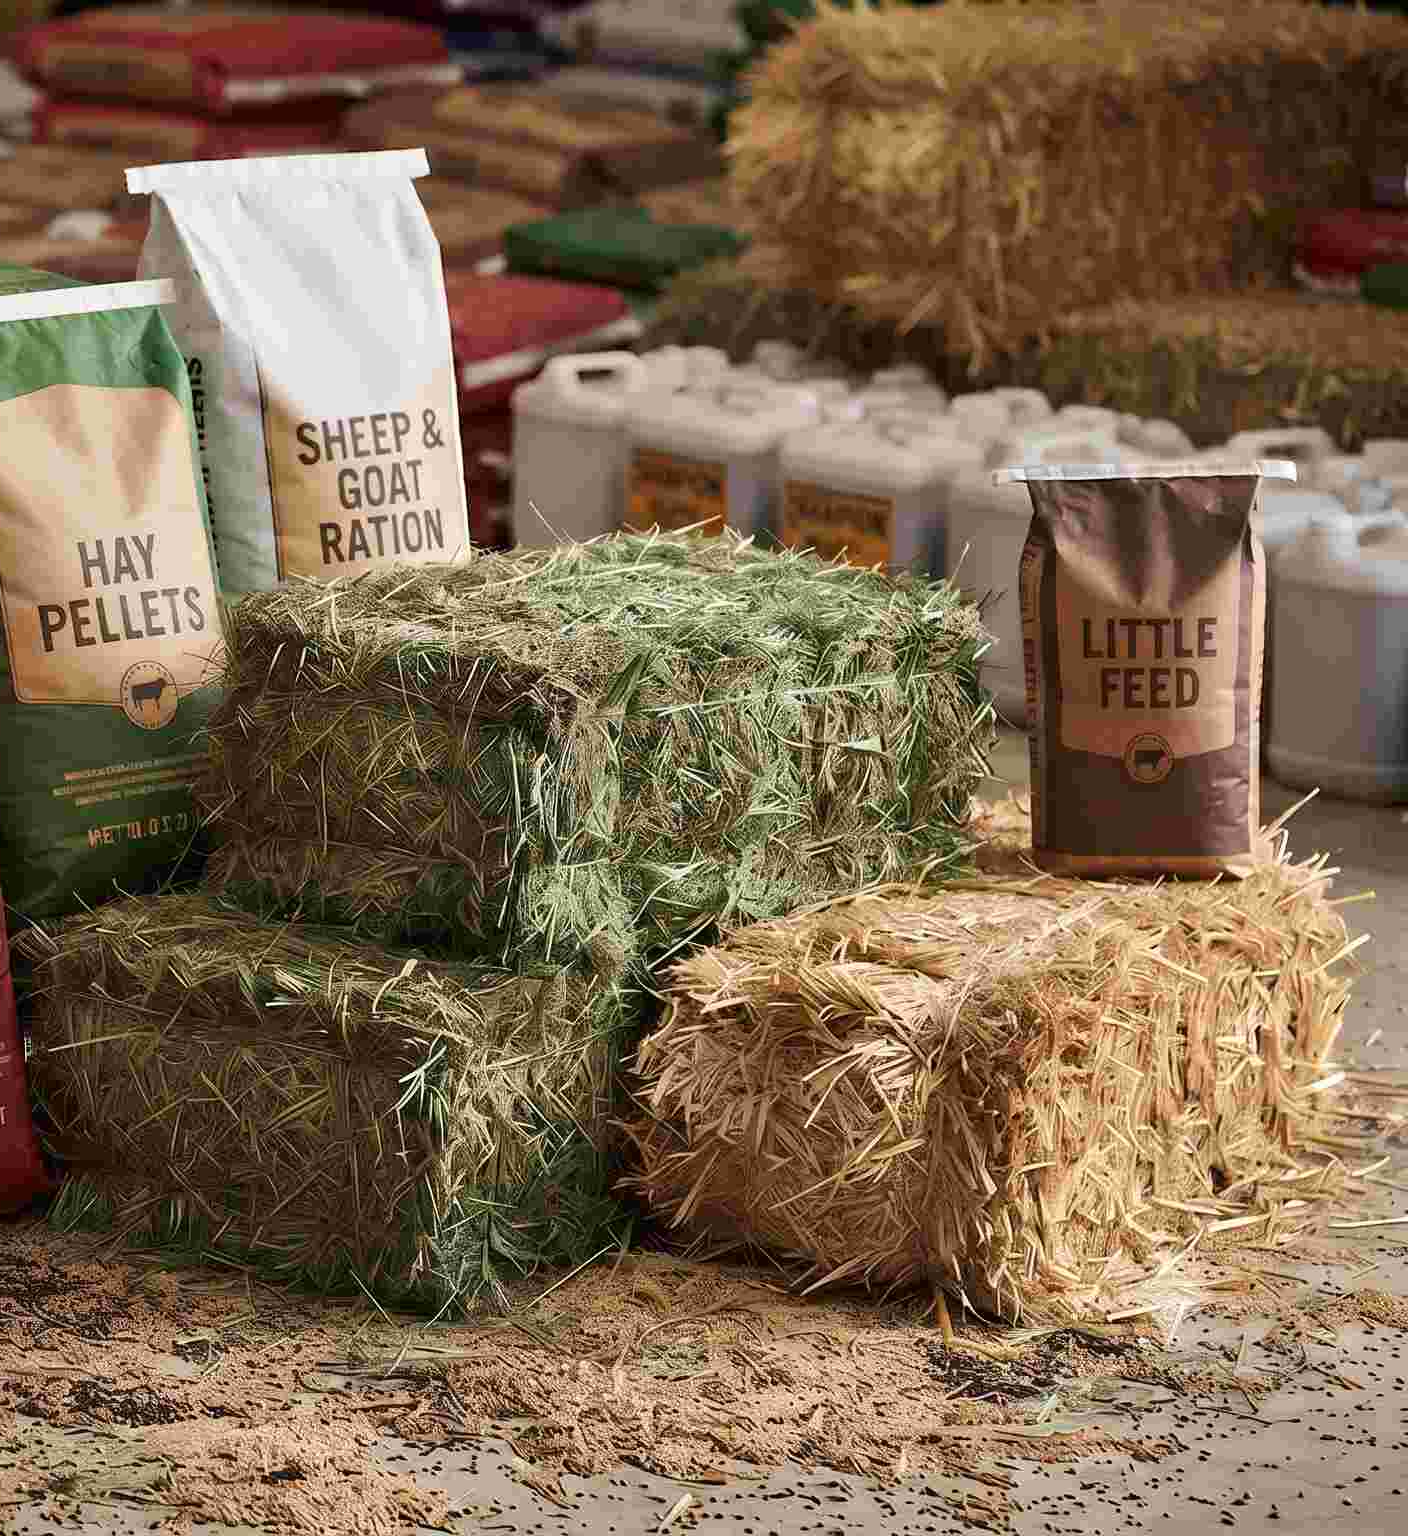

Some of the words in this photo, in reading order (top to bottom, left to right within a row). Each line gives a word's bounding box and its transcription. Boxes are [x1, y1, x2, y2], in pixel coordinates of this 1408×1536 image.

[295, 411, 411, 465] SHEEP
[422, 408, 445, 449] &
[337, 459, 423, 510] GOAT
[77, 534, 155, 587] HAY
[320, 508, 445, 565] RATION
[38, 587, 205, 652] PELLETS
[1081, 616, 1219, 659] LITTLE
[1100, 667, 1200, 709] FEED
